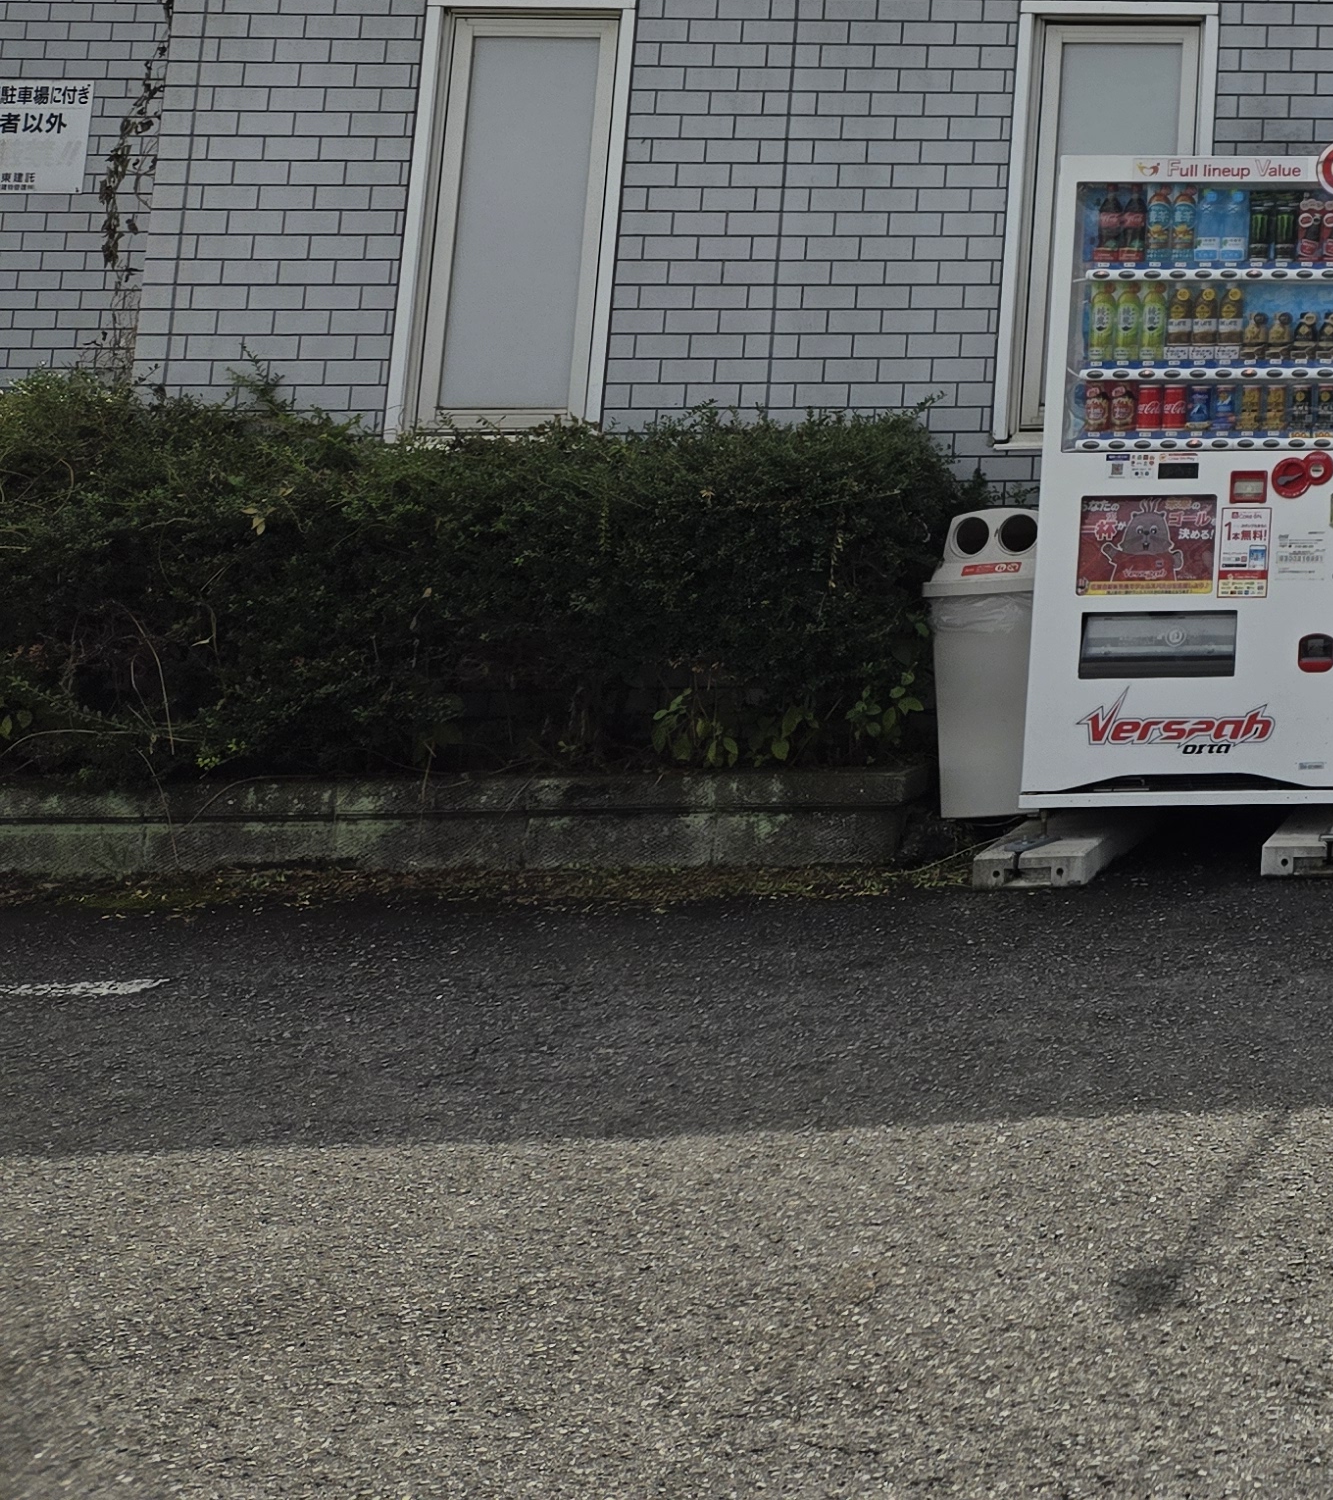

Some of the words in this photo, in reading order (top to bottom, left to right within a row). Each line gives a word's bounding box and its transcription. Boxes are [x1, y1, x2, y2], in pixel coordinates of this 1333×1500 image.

[0, 85, 90, 105] 駐車場に付き
[0, 113, 67, 134] 者以外
[1167, 159, 1198, 177] Full
[1203, 159, 1250, 179] lineup
[1255, 159, 1302, 177] Value
